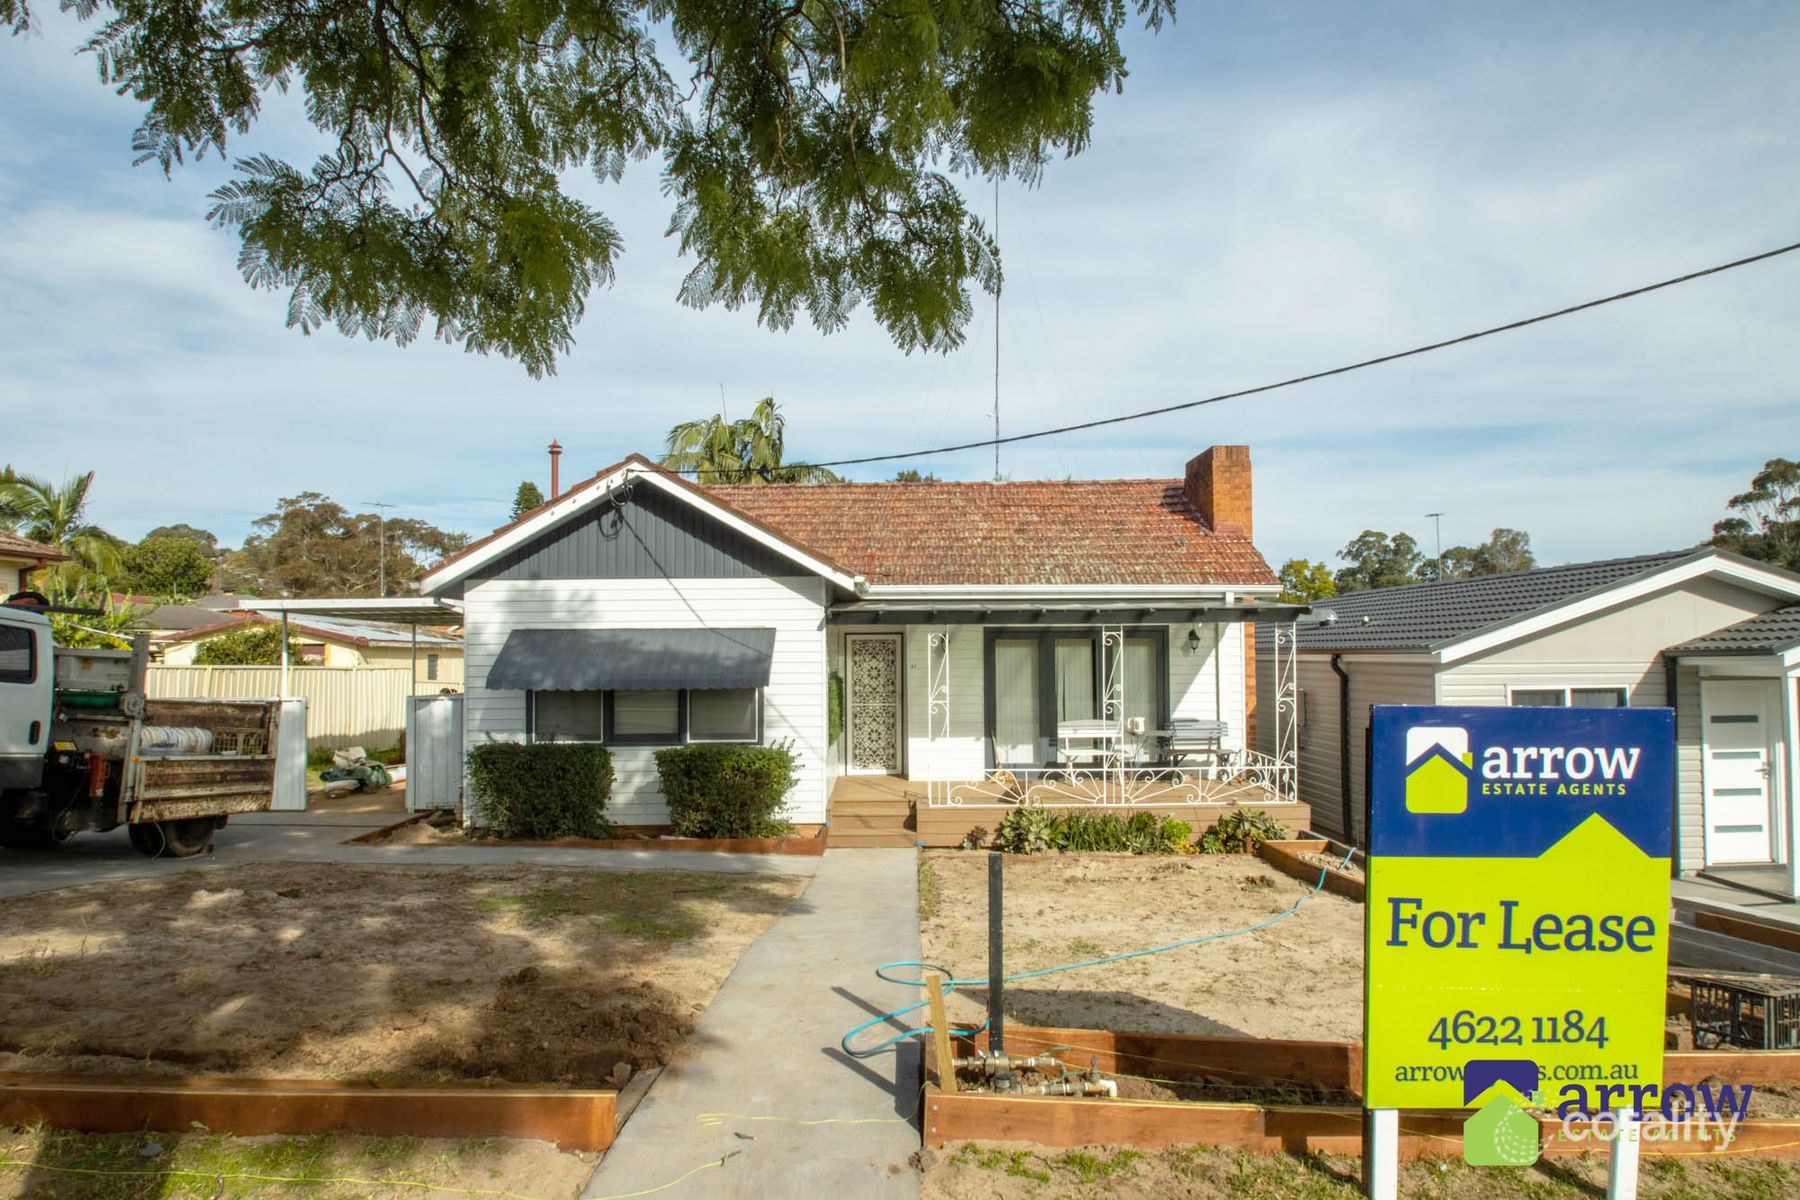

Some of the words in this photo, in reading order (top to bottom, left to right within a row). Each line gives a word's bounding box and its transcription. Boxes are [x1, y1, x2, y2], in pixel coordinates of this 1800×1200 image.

[1482, 746, 1640, 779] arrow
[1482, 783, 1547, 795] ESTATE
[1557, 783, 1626, 796] AGENTS
[1386, 897, 1486, 948] For
[1498, 900, 1656, 954] Lease
[1428, 1010, 1522, 1050] 4622
[1532, 1009, 1609, 1049] 1184
[1395, 1064, 1638, 1082] arrows.com.au
